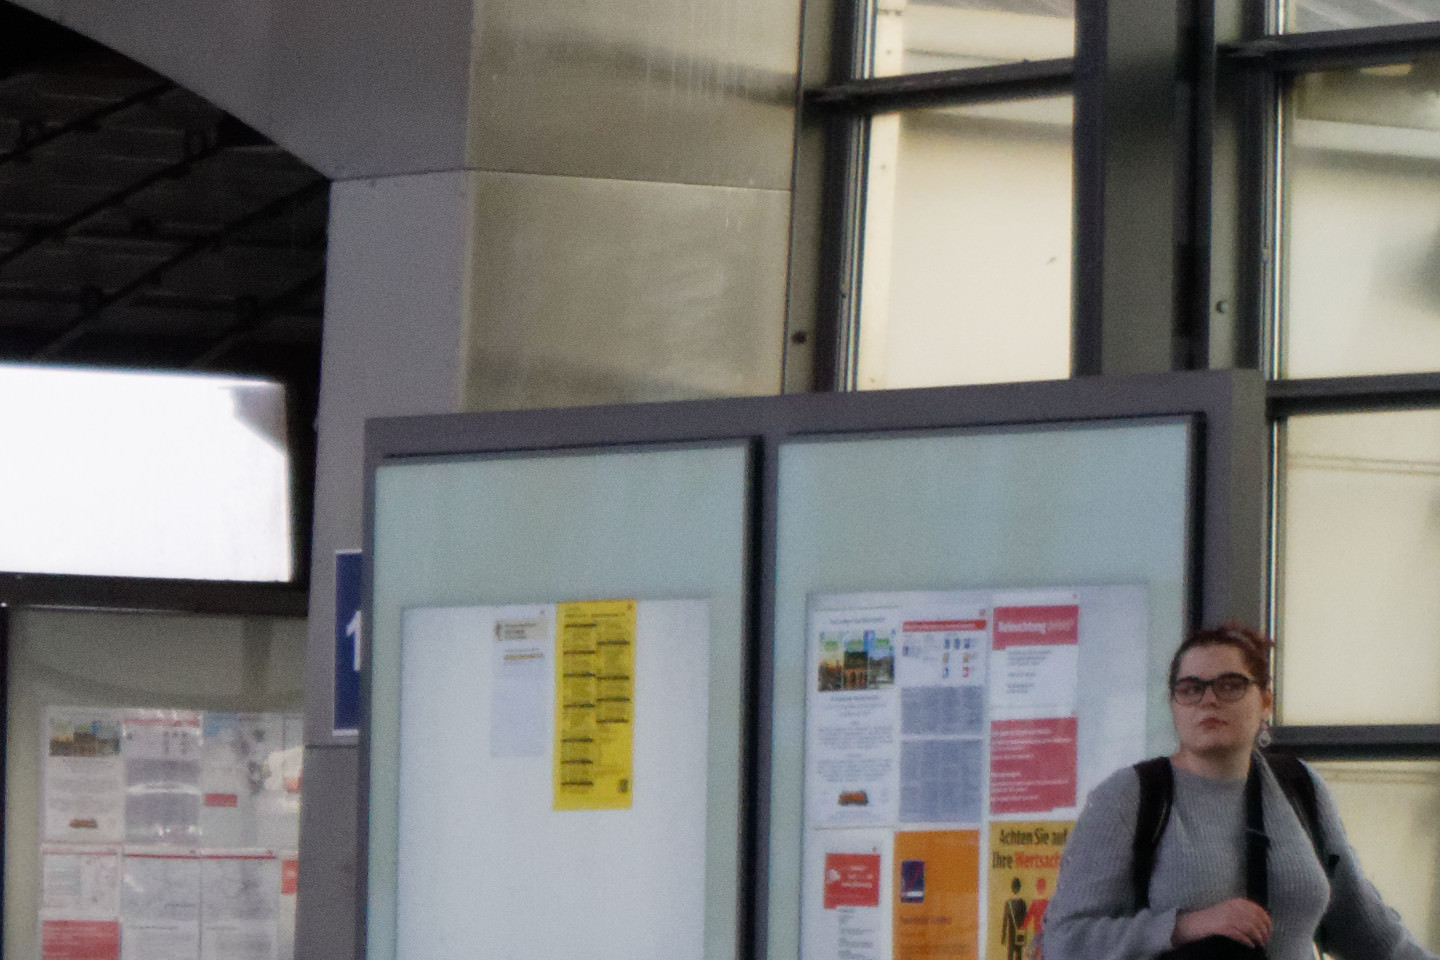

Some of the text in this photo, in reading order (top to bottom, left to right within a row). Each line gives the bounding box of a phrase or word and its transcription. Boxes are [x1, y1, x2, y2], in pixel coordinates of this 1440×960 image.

[345, 610, 361, 671] 1
[999, 828, 1033, 846] Achten
[1034, 827, 1049, 845] Sie
[992, 850, 1061, 869] Ihre Wertsach
